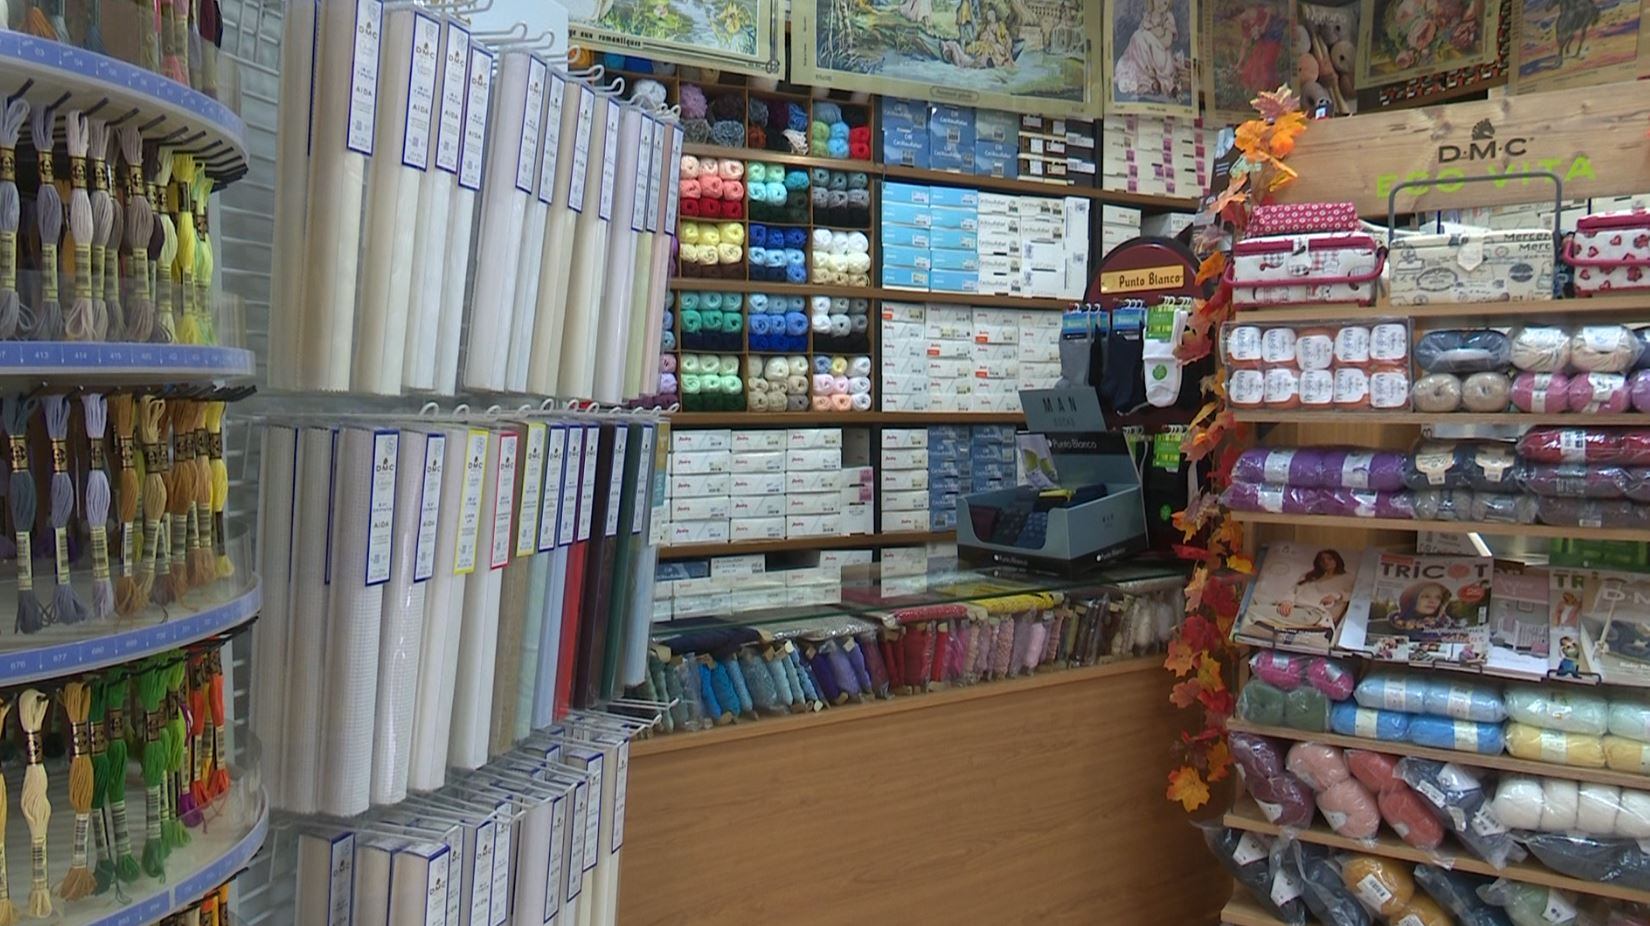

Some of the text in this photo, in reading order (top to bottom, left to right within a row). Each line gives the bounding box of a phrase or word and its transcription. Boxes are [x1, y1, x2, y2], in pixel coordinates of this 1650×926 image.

[416, 46, 435, 60] DMC
[1376, 156, 1597, 199] ECO VITA
[1119, 271, 1180, 289] Punto Blanco
[376, 464, 395, 473] DMC
[468, 462, 483, 470] DMC
